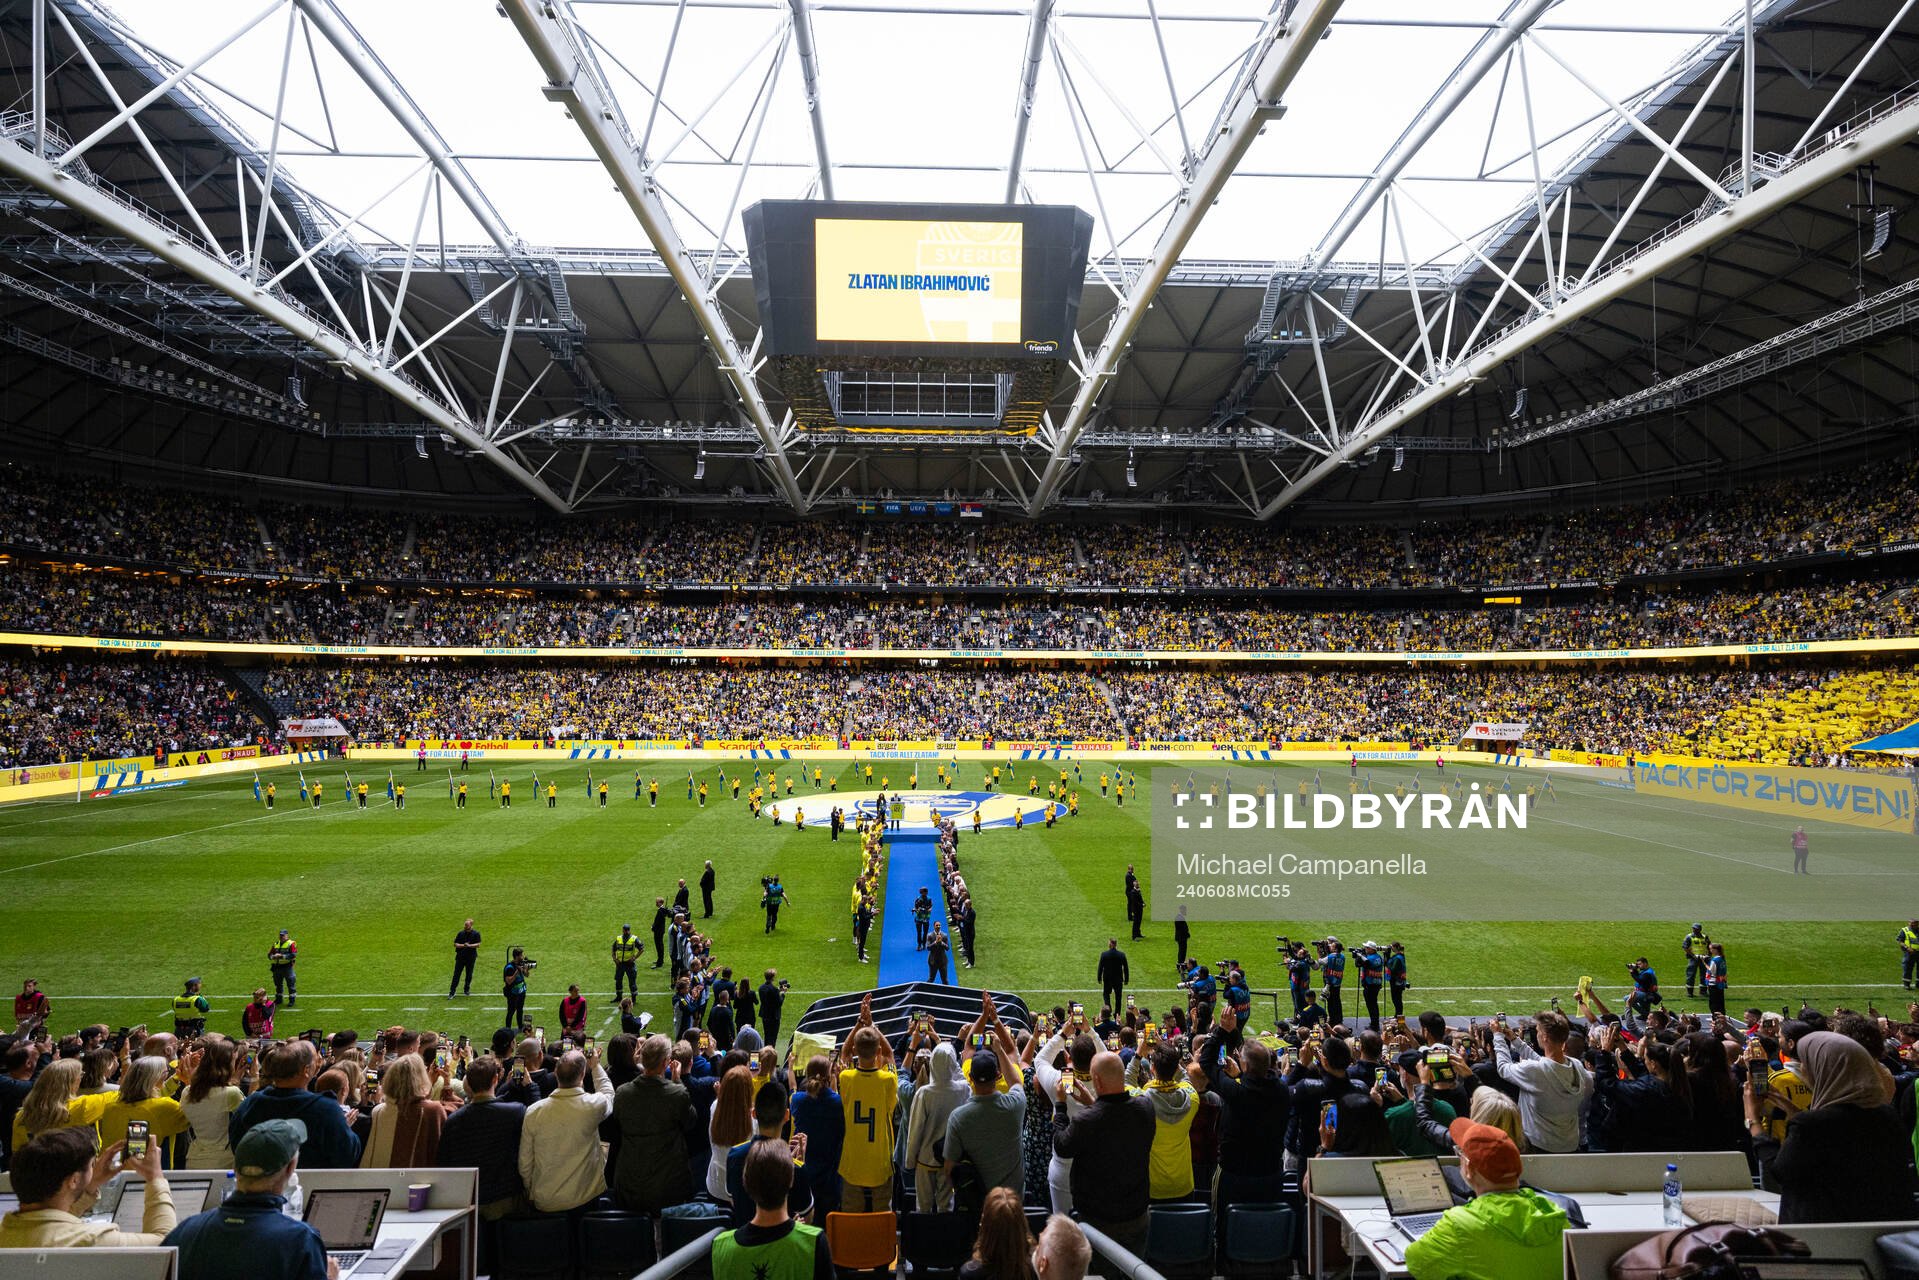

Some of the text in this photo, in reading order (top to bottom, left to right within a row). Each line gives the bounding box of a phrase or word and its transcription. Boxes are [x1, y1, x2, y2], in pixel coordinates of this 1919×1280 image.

[848, 273, 990, 292] ZLATAN IBRAHIMOVIĆ
[1029, 343, 1053, 352] friends
[1587, 754, 1622, 767] Scndic
[95, 762, 140, 776] Folksam
[1636, 762, 1910, 820] TACK FÖR ZHOWEN!
[854, 1100, 875, 1142] 4
